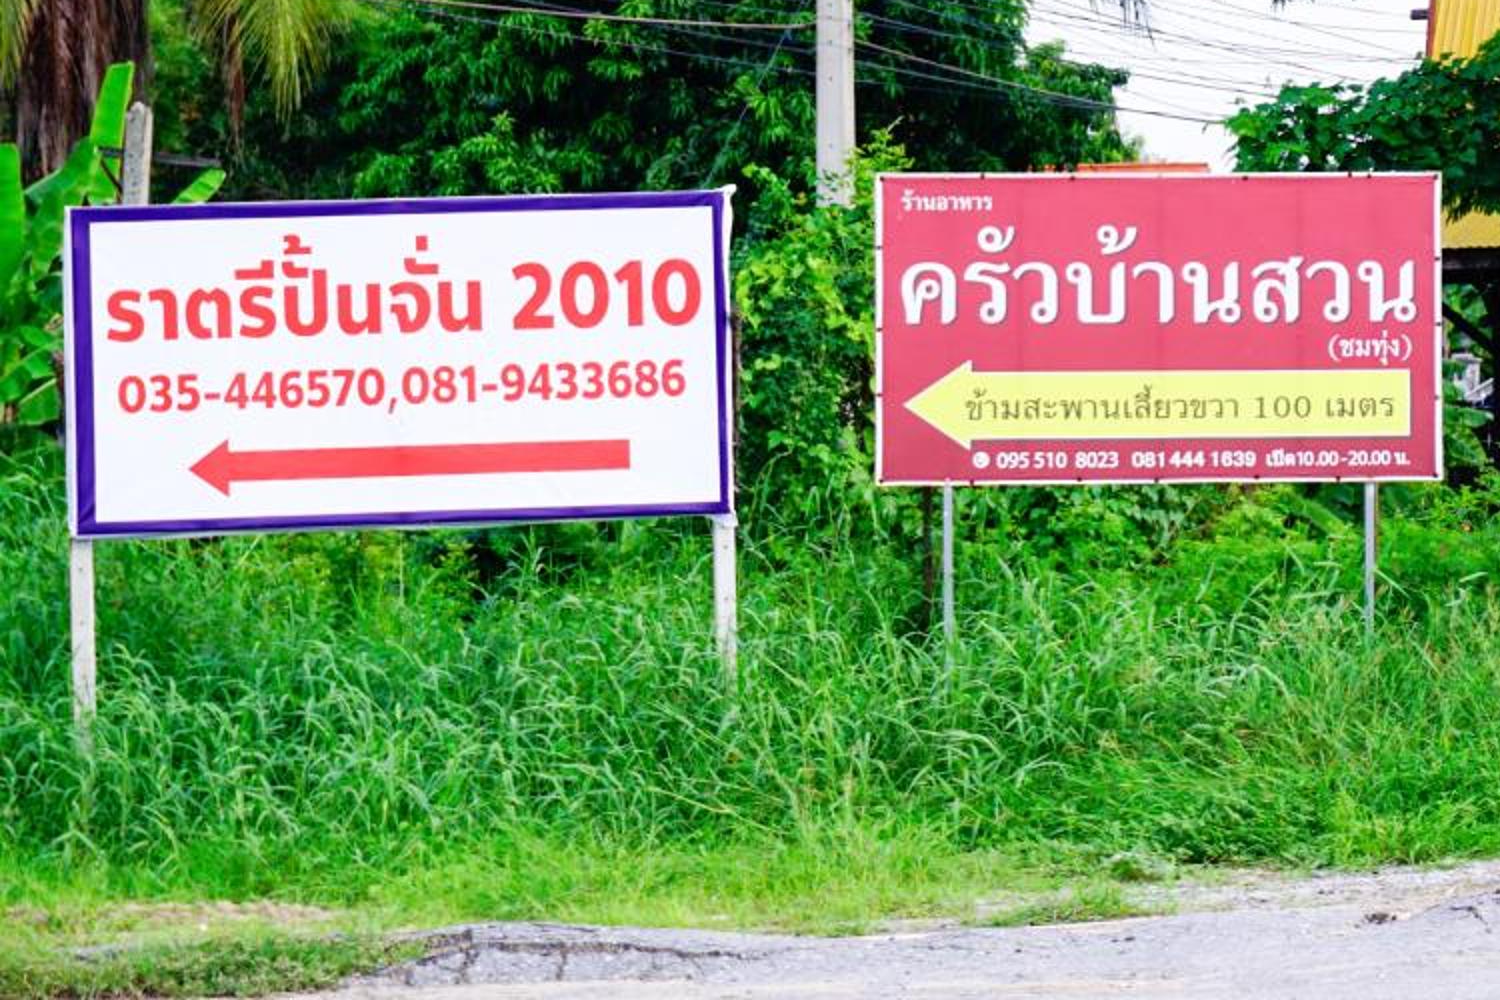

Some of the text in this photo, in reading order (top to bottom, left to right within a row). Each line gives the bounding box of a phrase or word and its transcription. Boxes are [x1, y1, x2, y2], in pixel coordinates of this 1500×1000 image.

[902, 189, 993, 211] ร้านอาหาร
[107, 234, 702, 343] ราตรีปั้นจั่น 2010
[900, 224, 1417, 325] ครัวบ้านสวน
[1328, 329, 1412, 366] (ชมทุ่ง)
[965, 385, 1395, 421] ข้ามสะพานเลี้ยวขวา 100 เมตร
